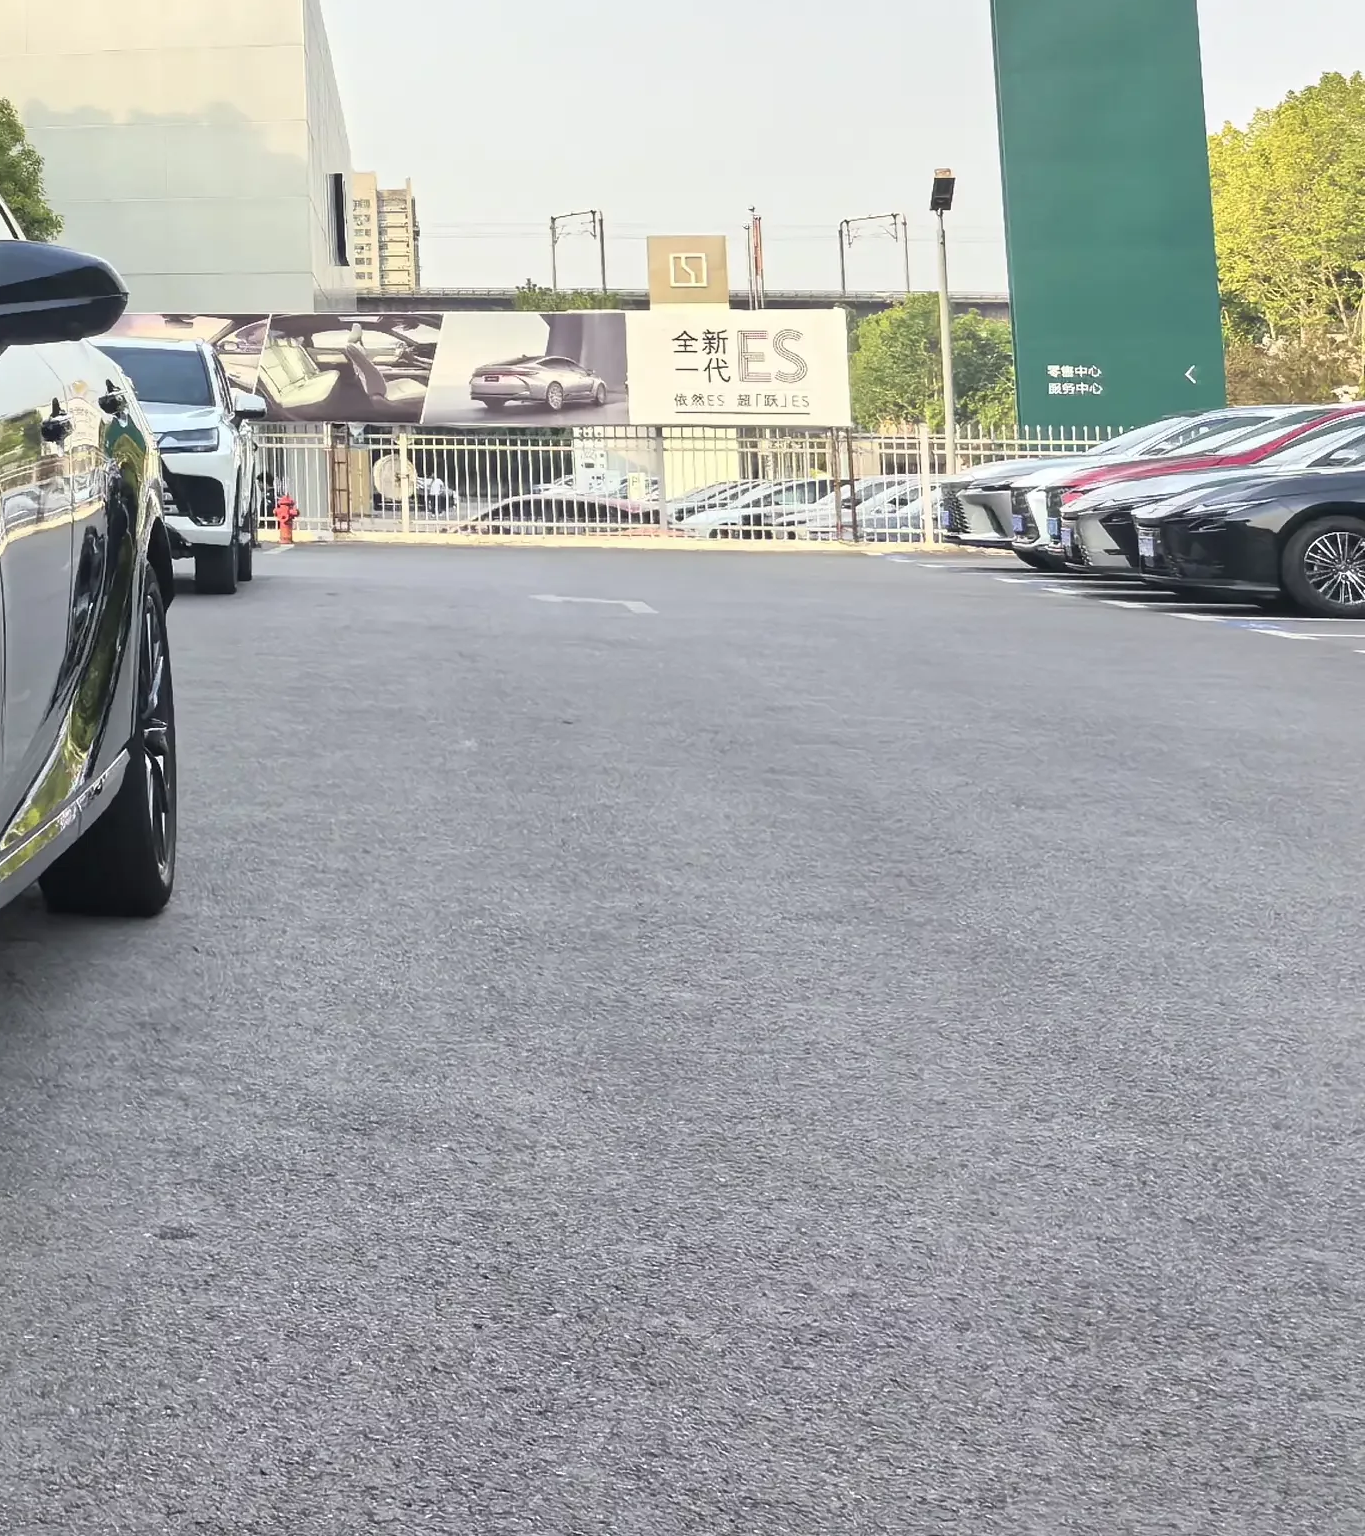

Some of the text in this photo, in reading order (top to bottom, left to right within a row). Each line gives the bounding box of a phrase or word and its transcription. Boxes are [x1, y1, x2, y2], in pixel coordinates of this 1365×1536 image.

[671, 329, 729, 355] 全新
[737, 328, 808, 383] ES
[674, 357, 731, 383] 一代
[674, 392, 726, 407] 依然ES
[1048, 382, 1104, 395] 服务中心
